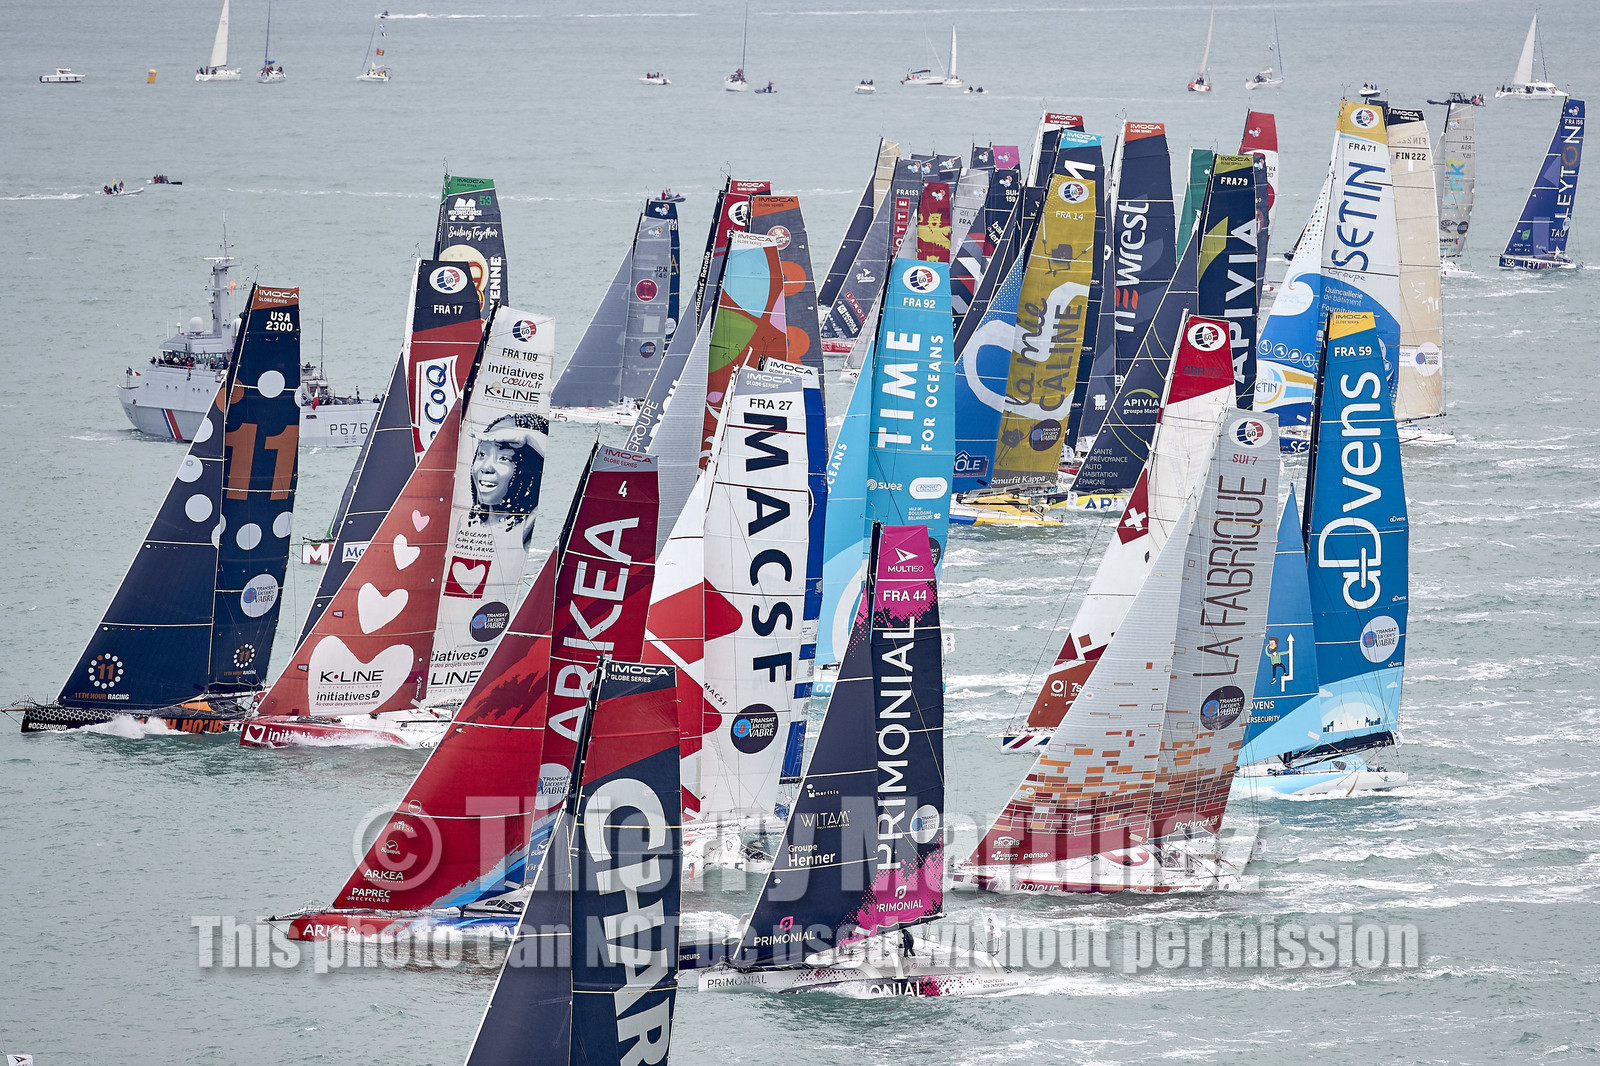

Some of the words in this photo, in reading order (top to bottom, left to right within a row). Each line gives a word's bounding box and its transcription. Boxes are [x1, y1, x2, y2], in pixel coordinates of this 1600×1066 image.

[1395, 151, 1410, 160] FIN
[1411, 152, 1427, 161] 222
[1220, 176, 1249, 186] FRA79
[480, 196, 492, 206] 53
[1056, 209, 1071, 219] FRA
[1073, 211, 1083, 220] 14
[1331, 161, 1387, 272] SETIN
[738, 234, 773, 243] IMOCA
[259, 290, 299, 300] IMOCA
[433, 304, 450, 315] FRA
[453, 304, 464, 315] 17
[903, 298, 923, 308] FRA
[923, 298, 936, 309] 92
[270, 311, 291, 322] USA
[265, 321, 295, 332] 2300
[502, 347, 520, 359] FRA
[523, 351, 538, 362] 109
[1334, 346, 1356, 357] FRA
[1358, 345, 1372, 356] 59
[488, 362, 544, 381] initiatives
[770, 361, 813, 376] IMOCA
[925, 335, 944, 408] OCEANS
[1182, 365, 1205, 377] GBR
[746, 372, 793, 385] IMOCA
[877, 331, 921, 448] TIME
[749, 398, 775, 410] FRA
[778, 400, 793, 411] 27
[1123, 398, 1160, 407] APIVIA
[329, 423, 368, 436] P676
[627, 400, 659, 452] GROUPE
[920, 418, 936, 451] FOR
[226, 424, 299, 501] 11
[605, 449, 653, 465] IMOCA
[991, 476, 1021, 485] Smurfit
[617, 480, 628, 498] 4
[743, 412, 793, 683] MACSF
[1200, 475, 1267, 626] FABRIQUE
[883, 590, 911, 601] FRA
[913, 590, 927, 601] 44
[97, 663, 117, 690] 11
[611, 664, 670, 677] IMOCA
[90, 692, 107, 701] HOUR
[108, 693, 130, 701] RACING
[316, 691, 371, 701] initiatives
[703, 682, 728, 706] MACSF
[749, 729, 775, 738] VABRE
[877, 616, 916, 870] PRIMONIAL
[1173, 819, 1210, 832] Roland
[788, 842, 818, 854] Groupe
[788, 852, 836, 868] Henner
[364, 869, 404, 882] ARKEA
[351, 887, 391, 899] PAPREC
[753, 930, 816, 947] PRIMONIAL
[707, 974, 768, 990] PRIMONIAL
